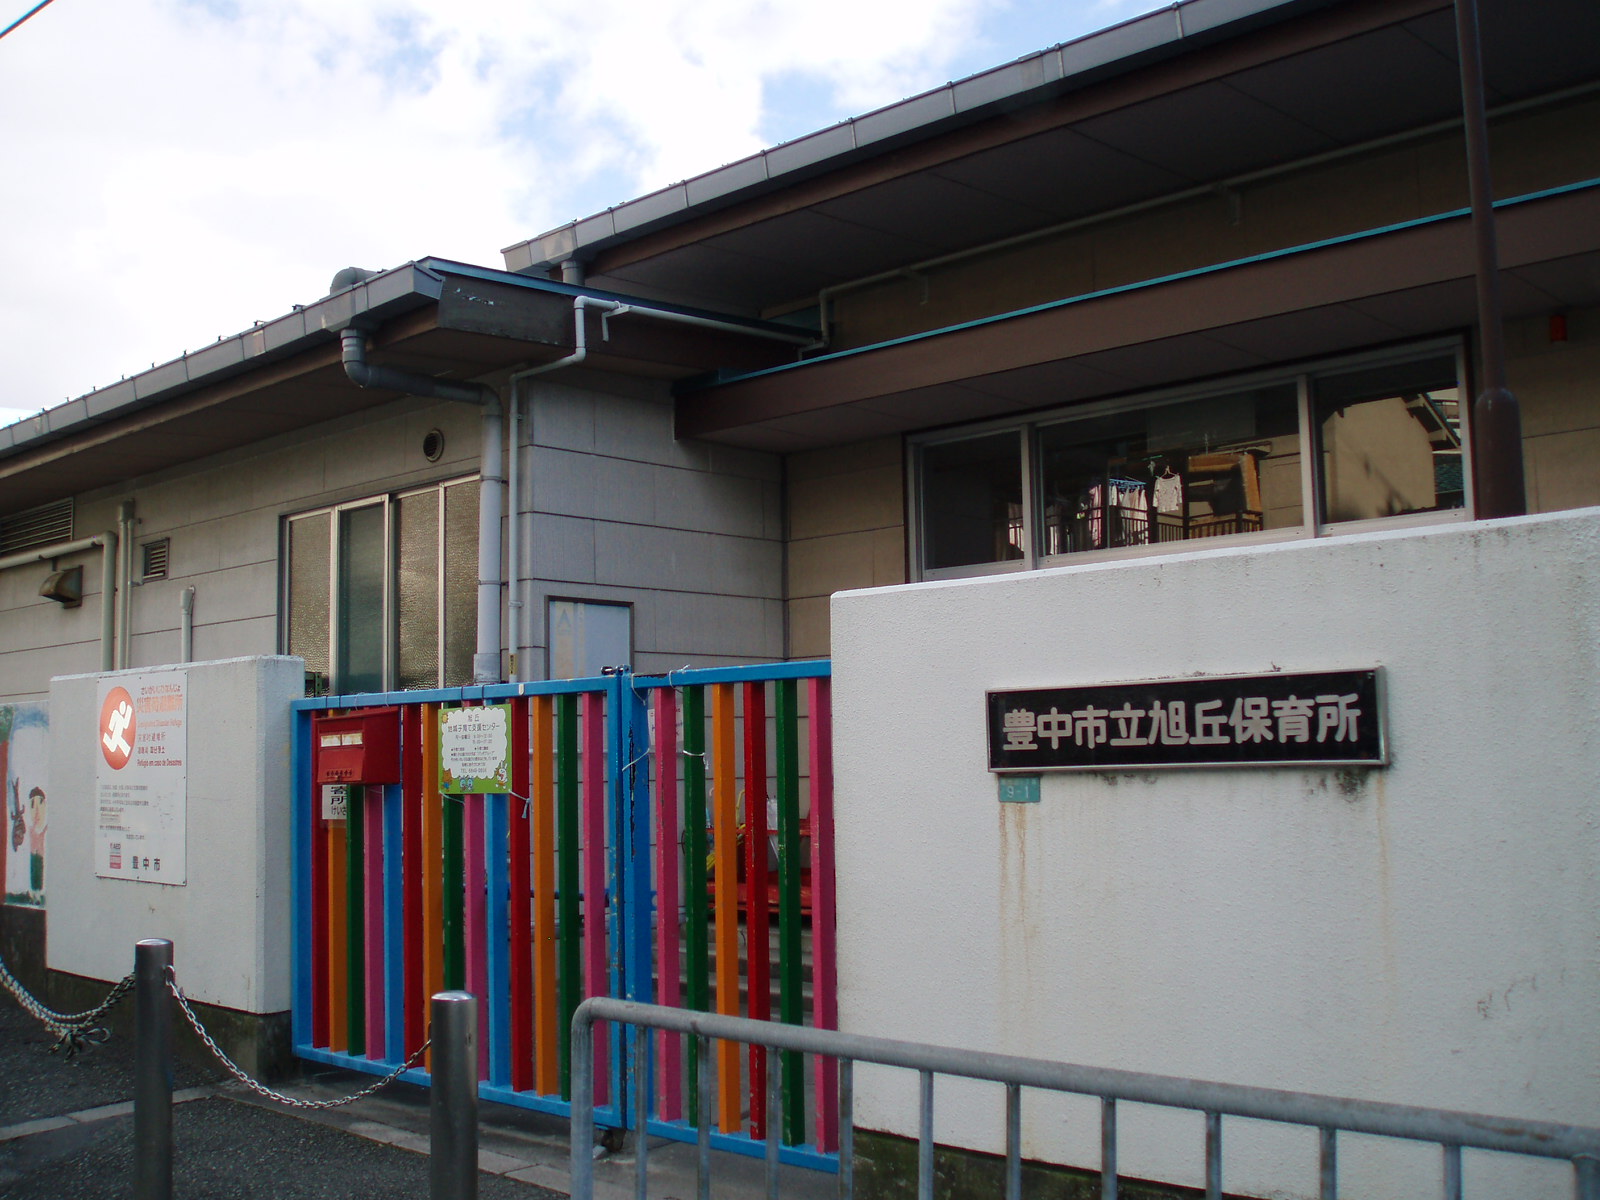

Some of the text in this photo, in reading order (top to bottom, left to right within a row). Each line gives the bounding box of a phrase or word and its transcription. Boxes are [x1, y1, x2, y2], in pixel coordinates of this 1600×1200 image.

[1002, 693, 1361, 751] 豊中市立旭丘保育所
